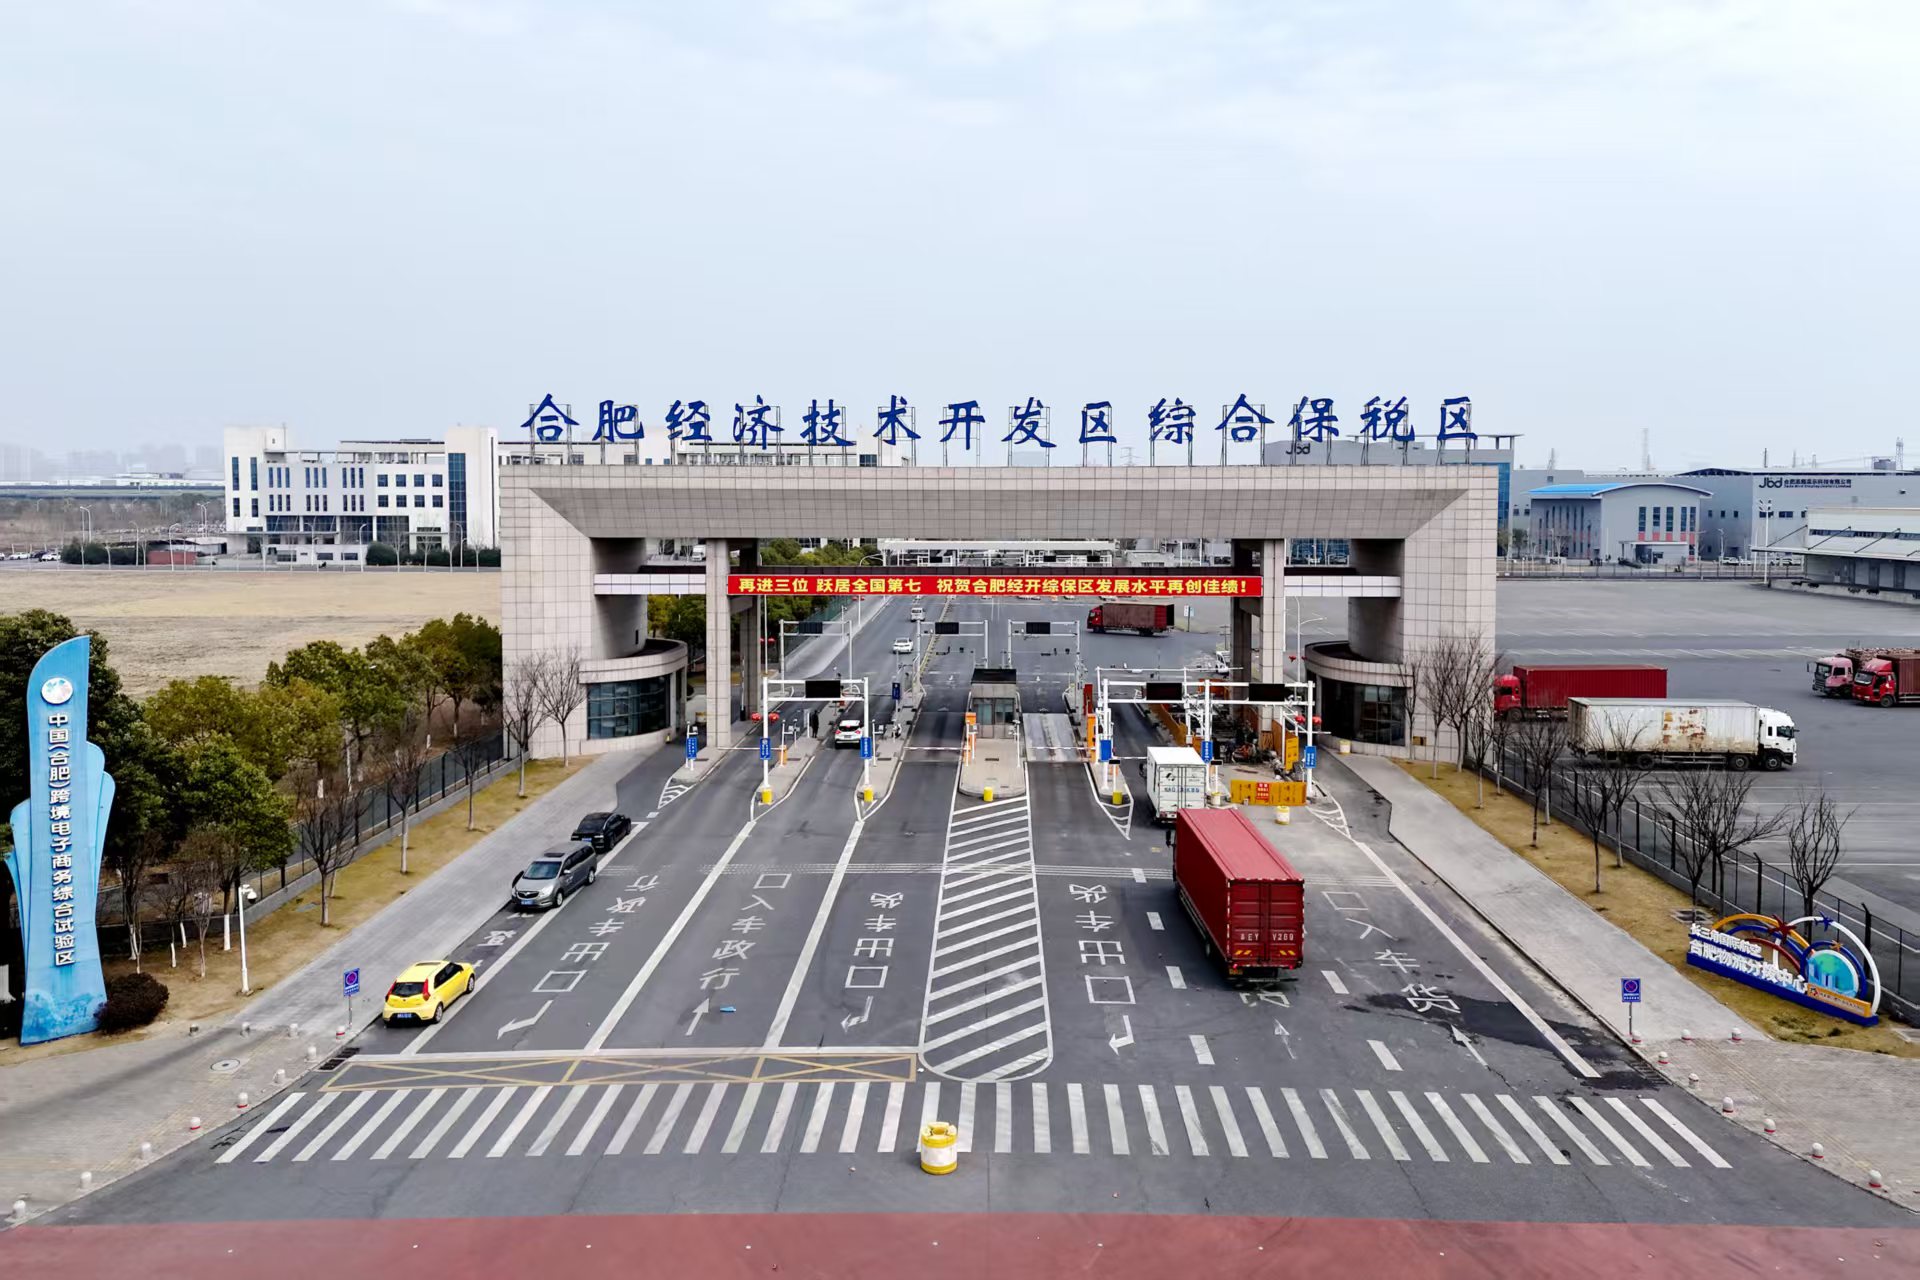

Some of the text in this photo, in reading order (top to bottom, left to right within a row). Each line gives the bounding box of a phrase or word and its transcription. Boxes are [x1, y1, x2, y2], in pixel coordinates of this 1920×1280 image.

[520, 393, 1478, 450] 合肥经济技术开发区综合保税区
[737, 578, 809, 594] 再进三位
[816, 578, 922, 594] 跃居全国第七
